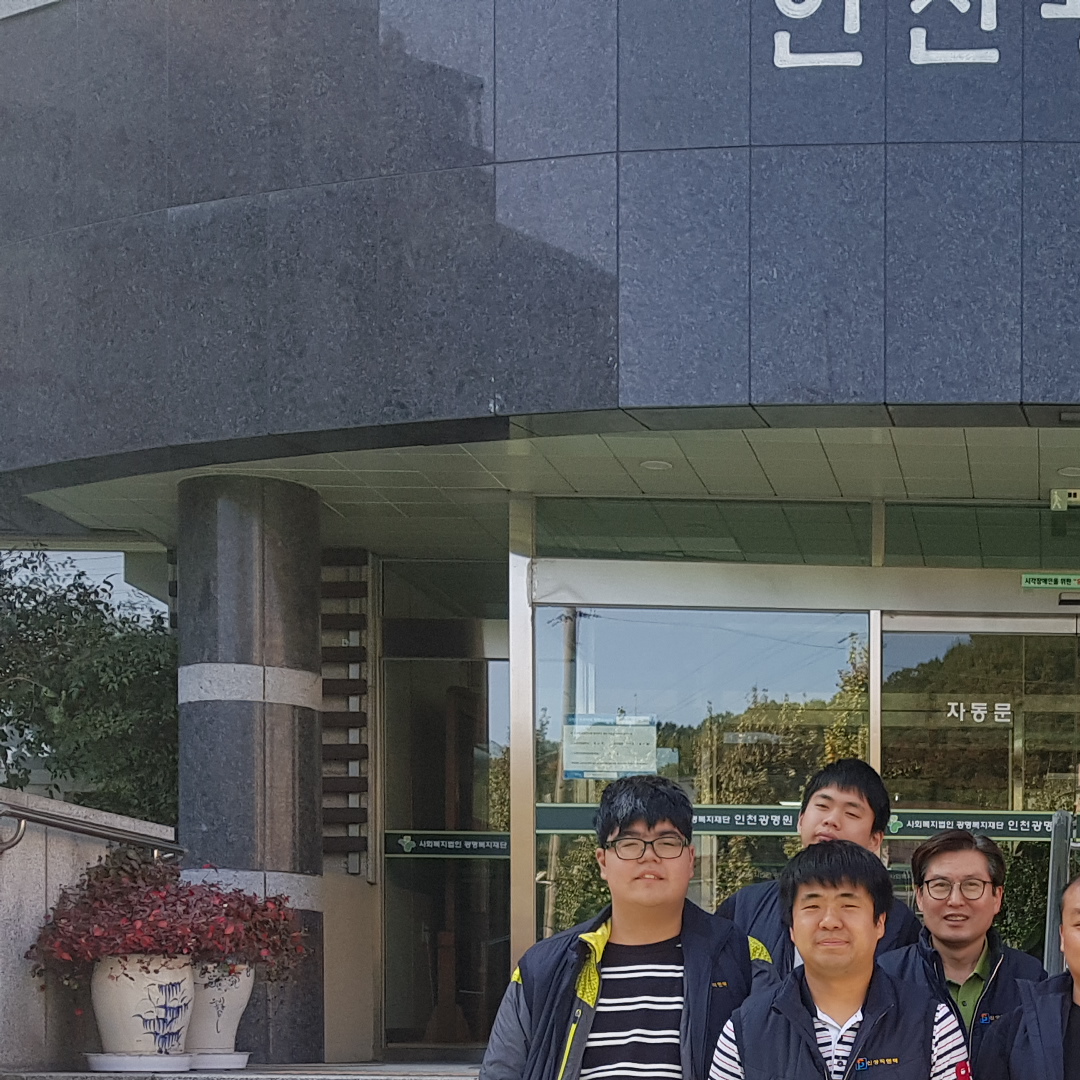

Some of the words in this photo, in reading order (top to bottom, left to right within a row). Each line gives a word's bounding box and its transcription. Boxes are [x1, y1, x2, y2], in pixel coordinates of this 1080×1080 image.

[947, 702, 1012, 723] 자동문
[734, 814, 793, 826] 인천광명원
[906, 820, 954, 829] 사회복지법인
[1007, 820, 1052, 832] 인천광명
